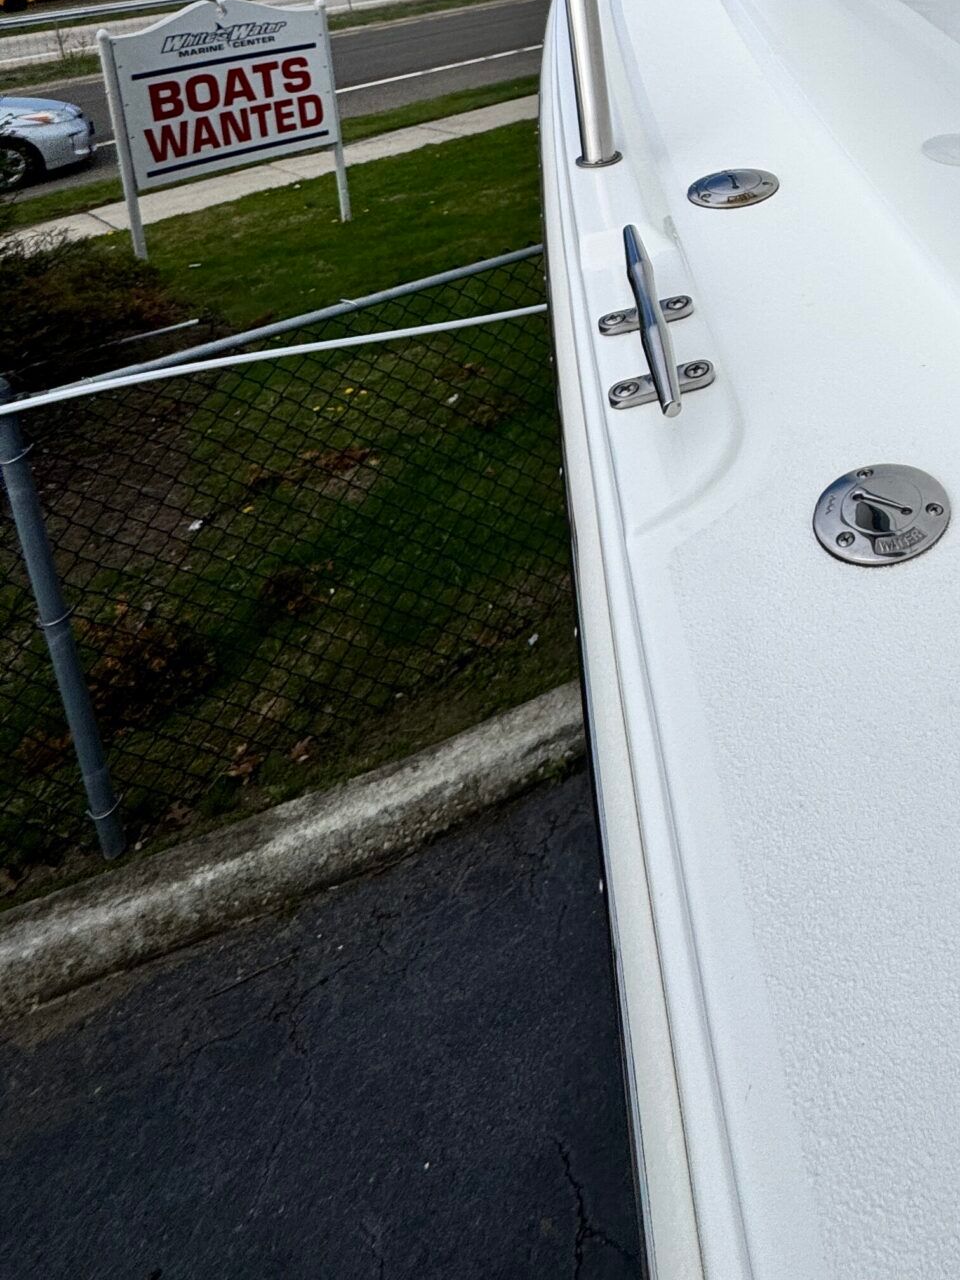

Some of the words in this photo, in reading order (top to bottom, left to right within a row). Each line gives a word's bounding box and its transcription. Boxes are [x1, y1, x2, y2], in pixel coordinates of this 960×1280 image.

[178, 44, 225, 58] MARINE
[232, 35, 276, 49] CENTER
[148, 56, 312, 122] BOATS
[143, 94, 324, 164] WANTED
[877, 528, 924, 554] WATER
